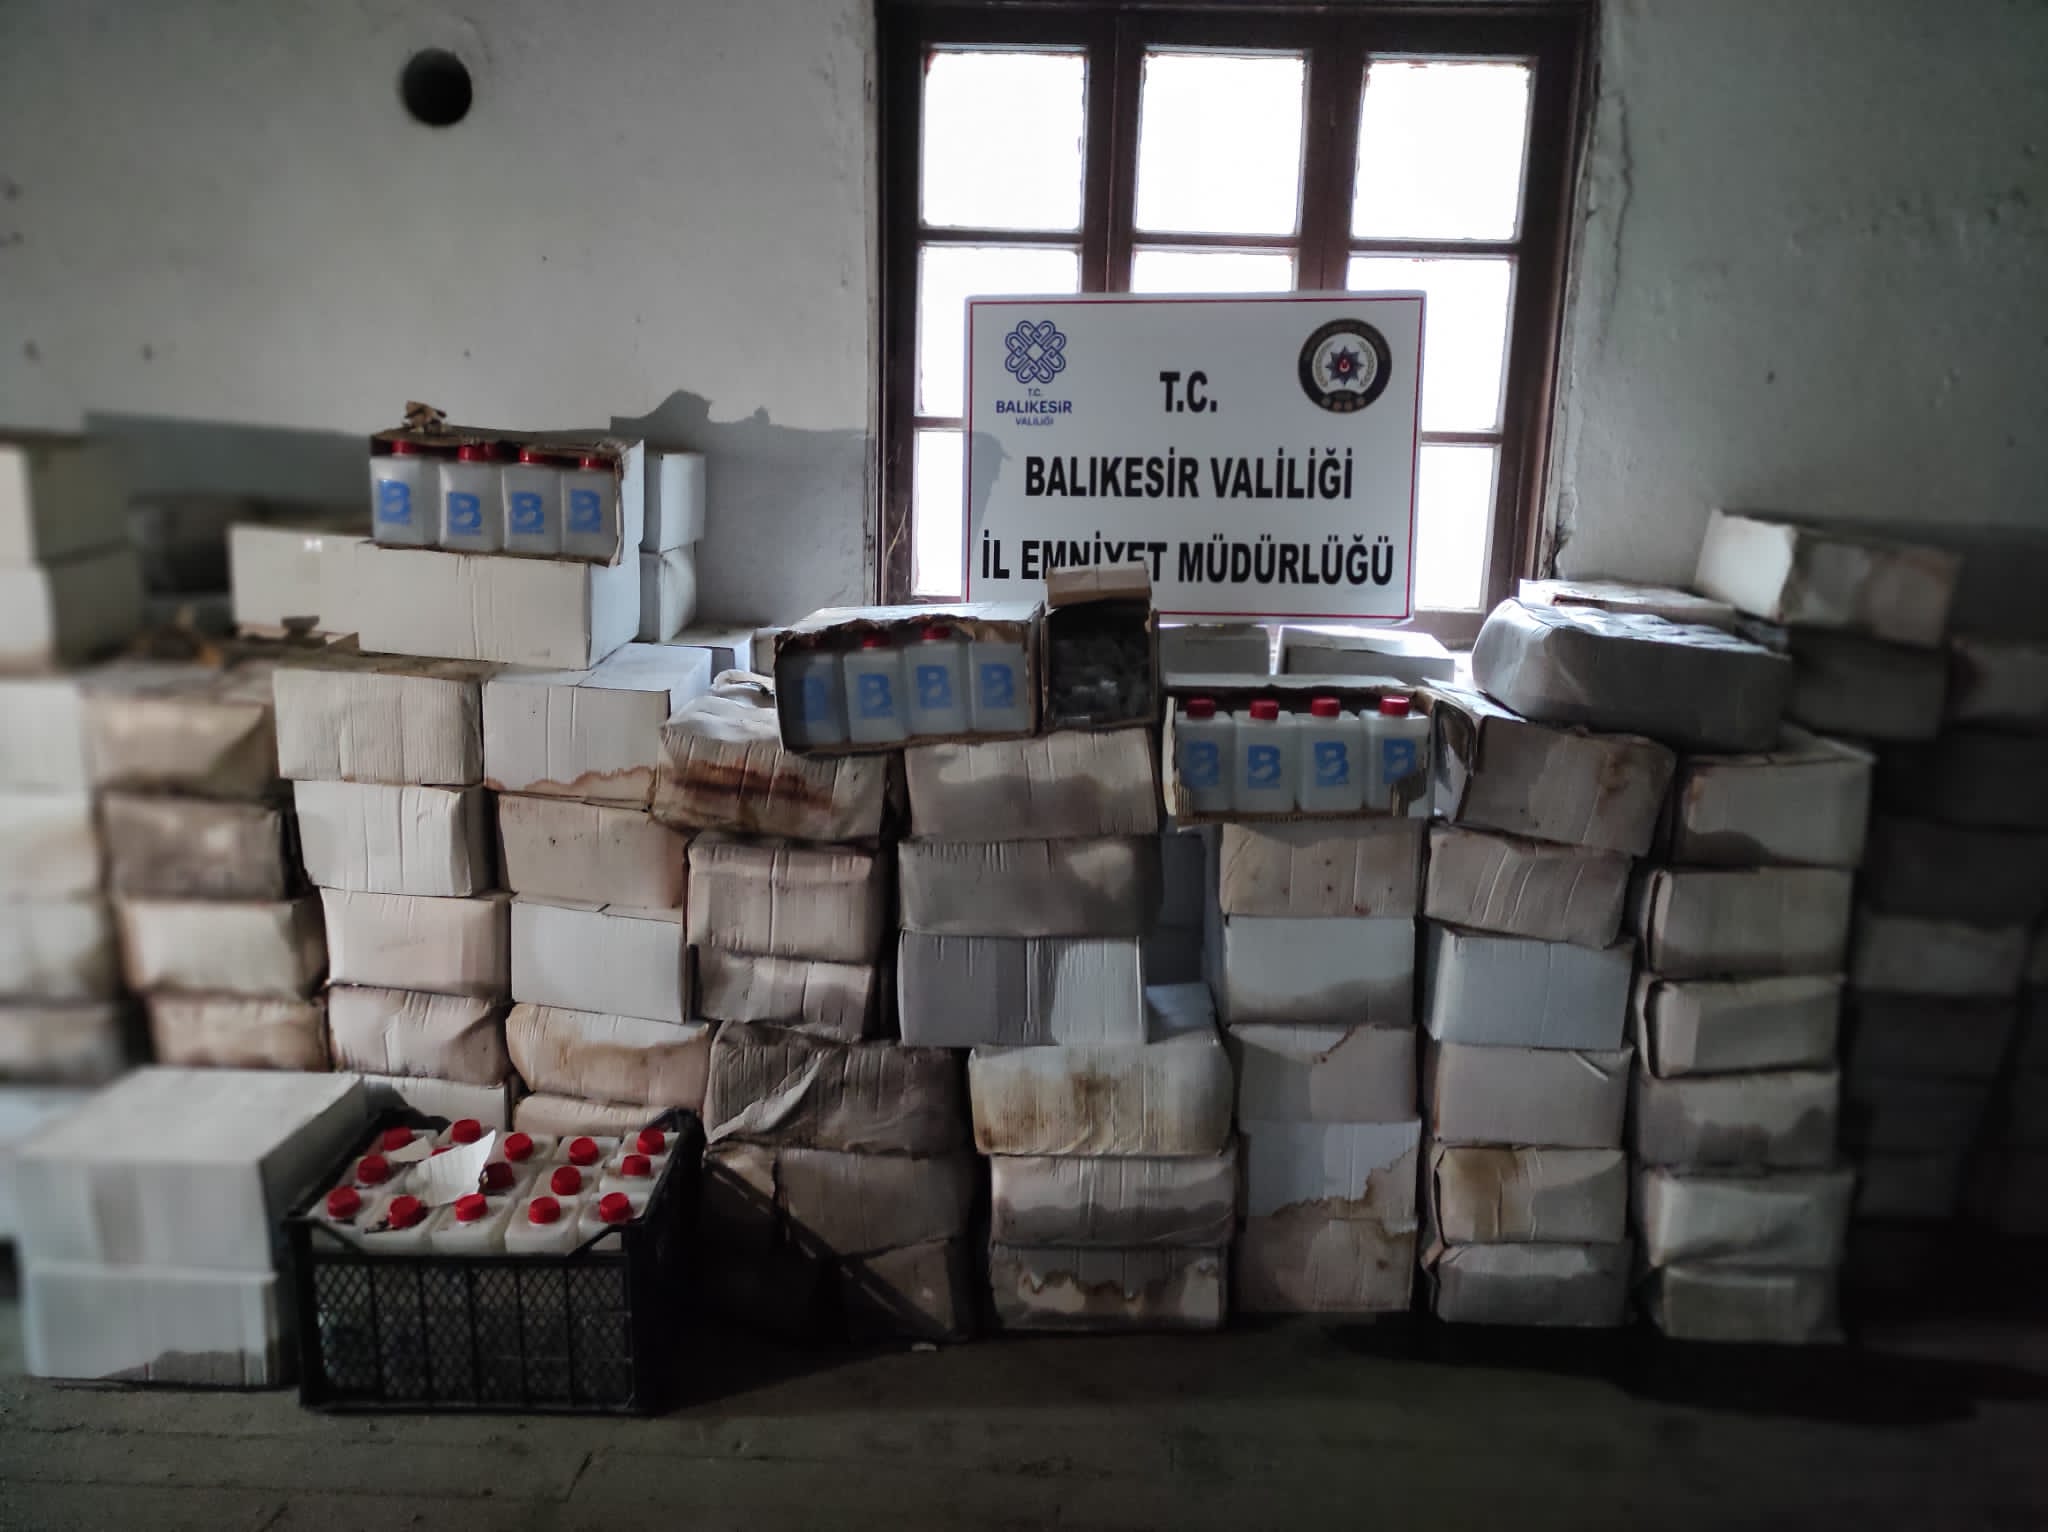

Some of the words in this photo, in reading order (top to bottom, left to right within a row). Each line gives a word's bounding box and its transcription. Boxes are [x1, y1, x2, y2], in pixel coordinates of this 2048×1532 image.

[1160, 371, 1217, 413] T.C.
[1026, 446, 1199, 498] BALIKESİR
[1211, 447, 1353, 500] VALİLİĞİ
[379, 480, 410, 522] B
[448, 492, 482, 528] B
[511, 492, 544, 528] B
[571, 489, 602, 528] B
[983, 529, 1010, 579] İL
[1178, 533, 1394, 586] MÜDÜRLÜĞÜ
